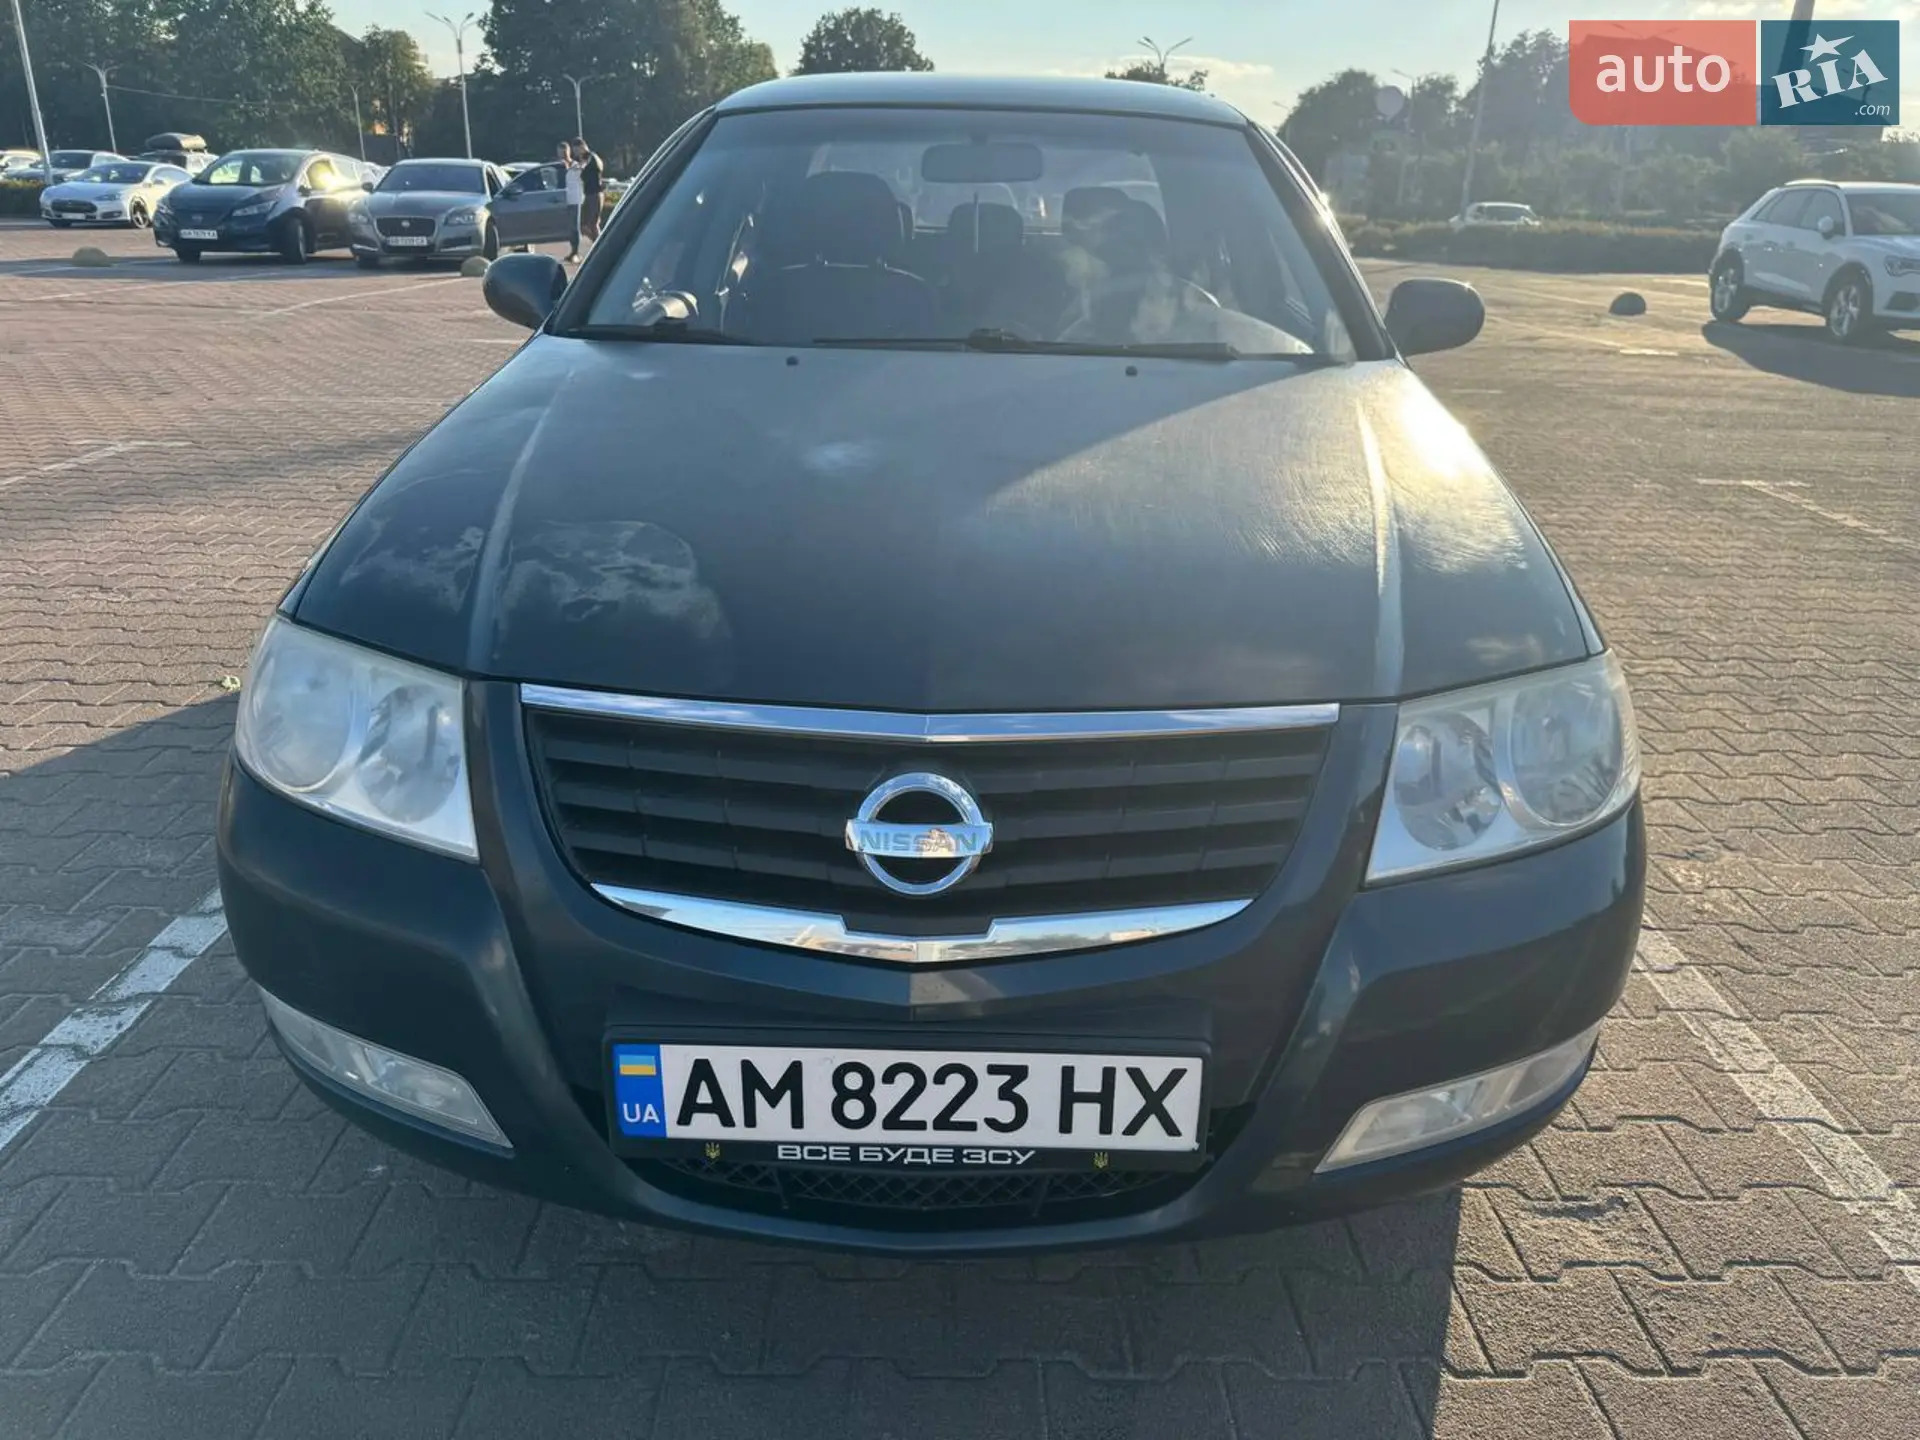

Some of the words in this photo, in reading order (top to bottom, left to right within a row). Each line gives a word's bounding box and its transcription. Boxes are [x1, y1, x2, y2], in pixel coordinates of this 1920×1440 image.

[859, 830, 977, 852] NISSAN
[676, 1058, 805, 1130] AM
[831, 1061, 1030, 1134] 8223
[1058, 1065, 1188, 1137] HX
[622, 1102, 661, 1124] UA
[777, 1145, 852, 1163] ВСЕ
[858, 1146, 955, 1165] БУДЕ
[962, 1149, 1036, 1165] ЗСУ
